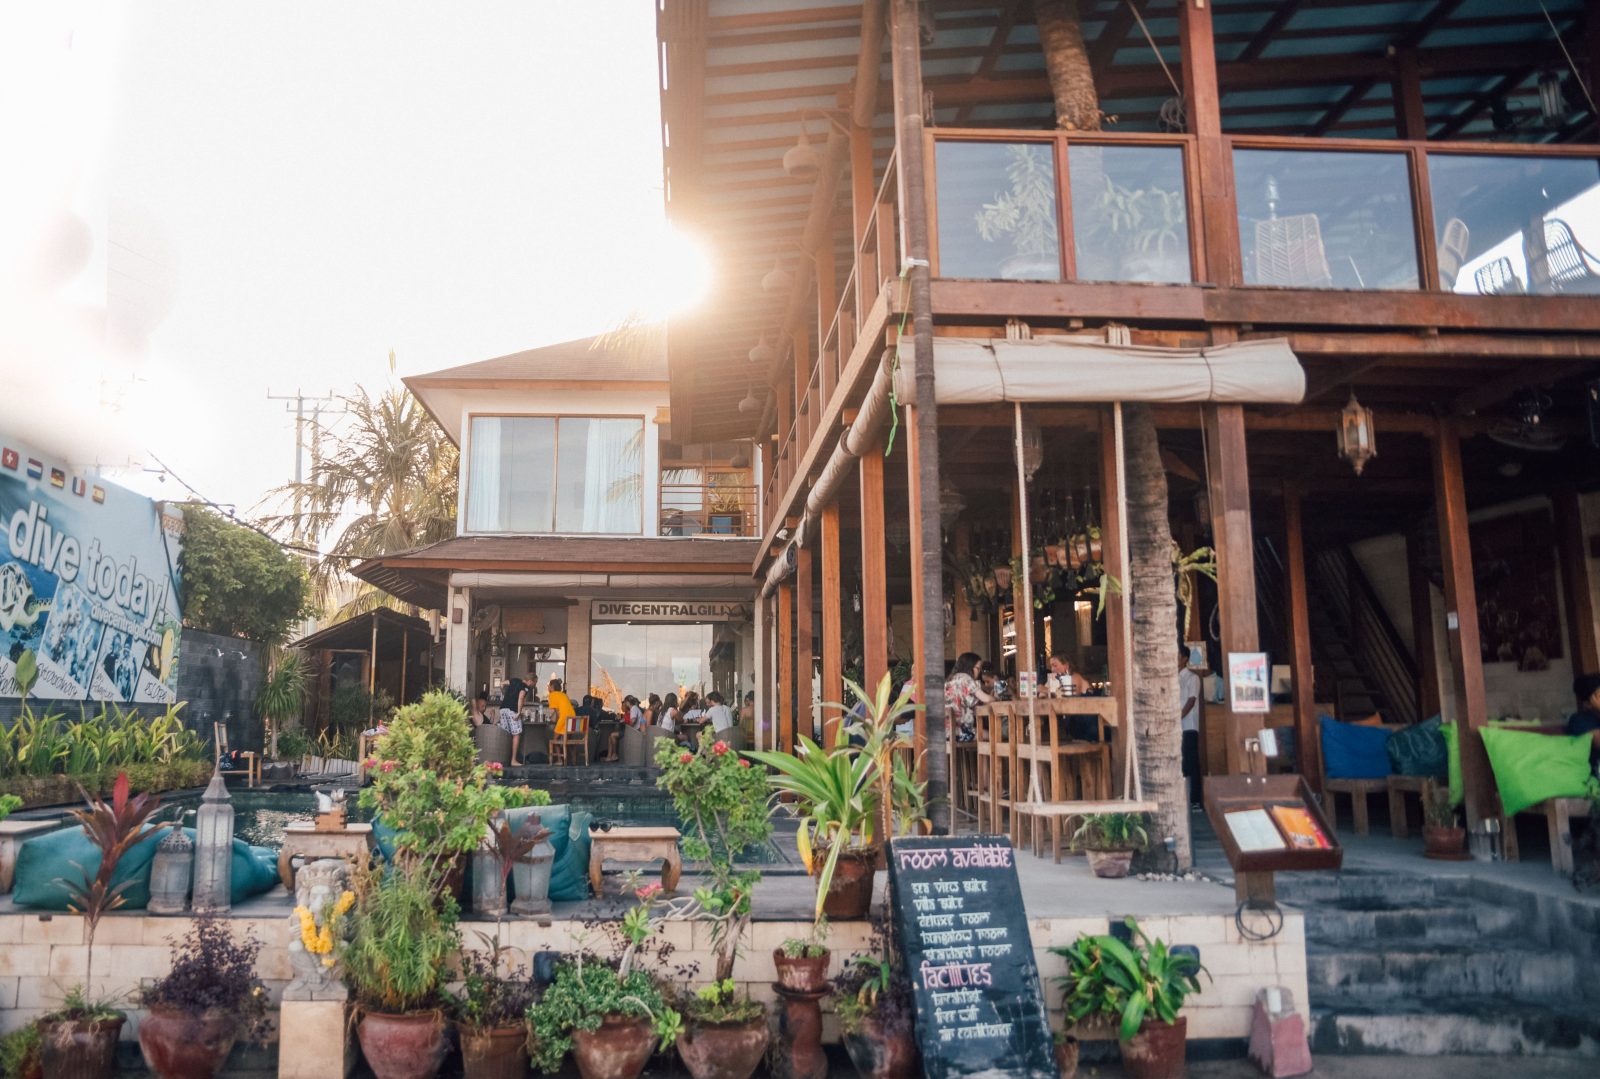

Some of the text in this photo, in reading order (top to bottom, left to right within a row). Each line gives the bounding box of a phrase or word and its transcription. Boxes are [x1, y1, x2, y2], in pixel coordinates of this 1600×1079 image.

[8, 501, 170, 629] dive today!
[898, 843, 1012, 870] room available
[911, 878, 988, 895] sea view suite
[912, 895, 964, 911] villa suite
[917, 912, 991, 927] deluxe room
[920, 927, 1008, 945] bungalow room
[922, 943, 1012, 960] standard room
[920, 960, 992, 990] facilities
[934, 1004, 980, 1023] free wifi
